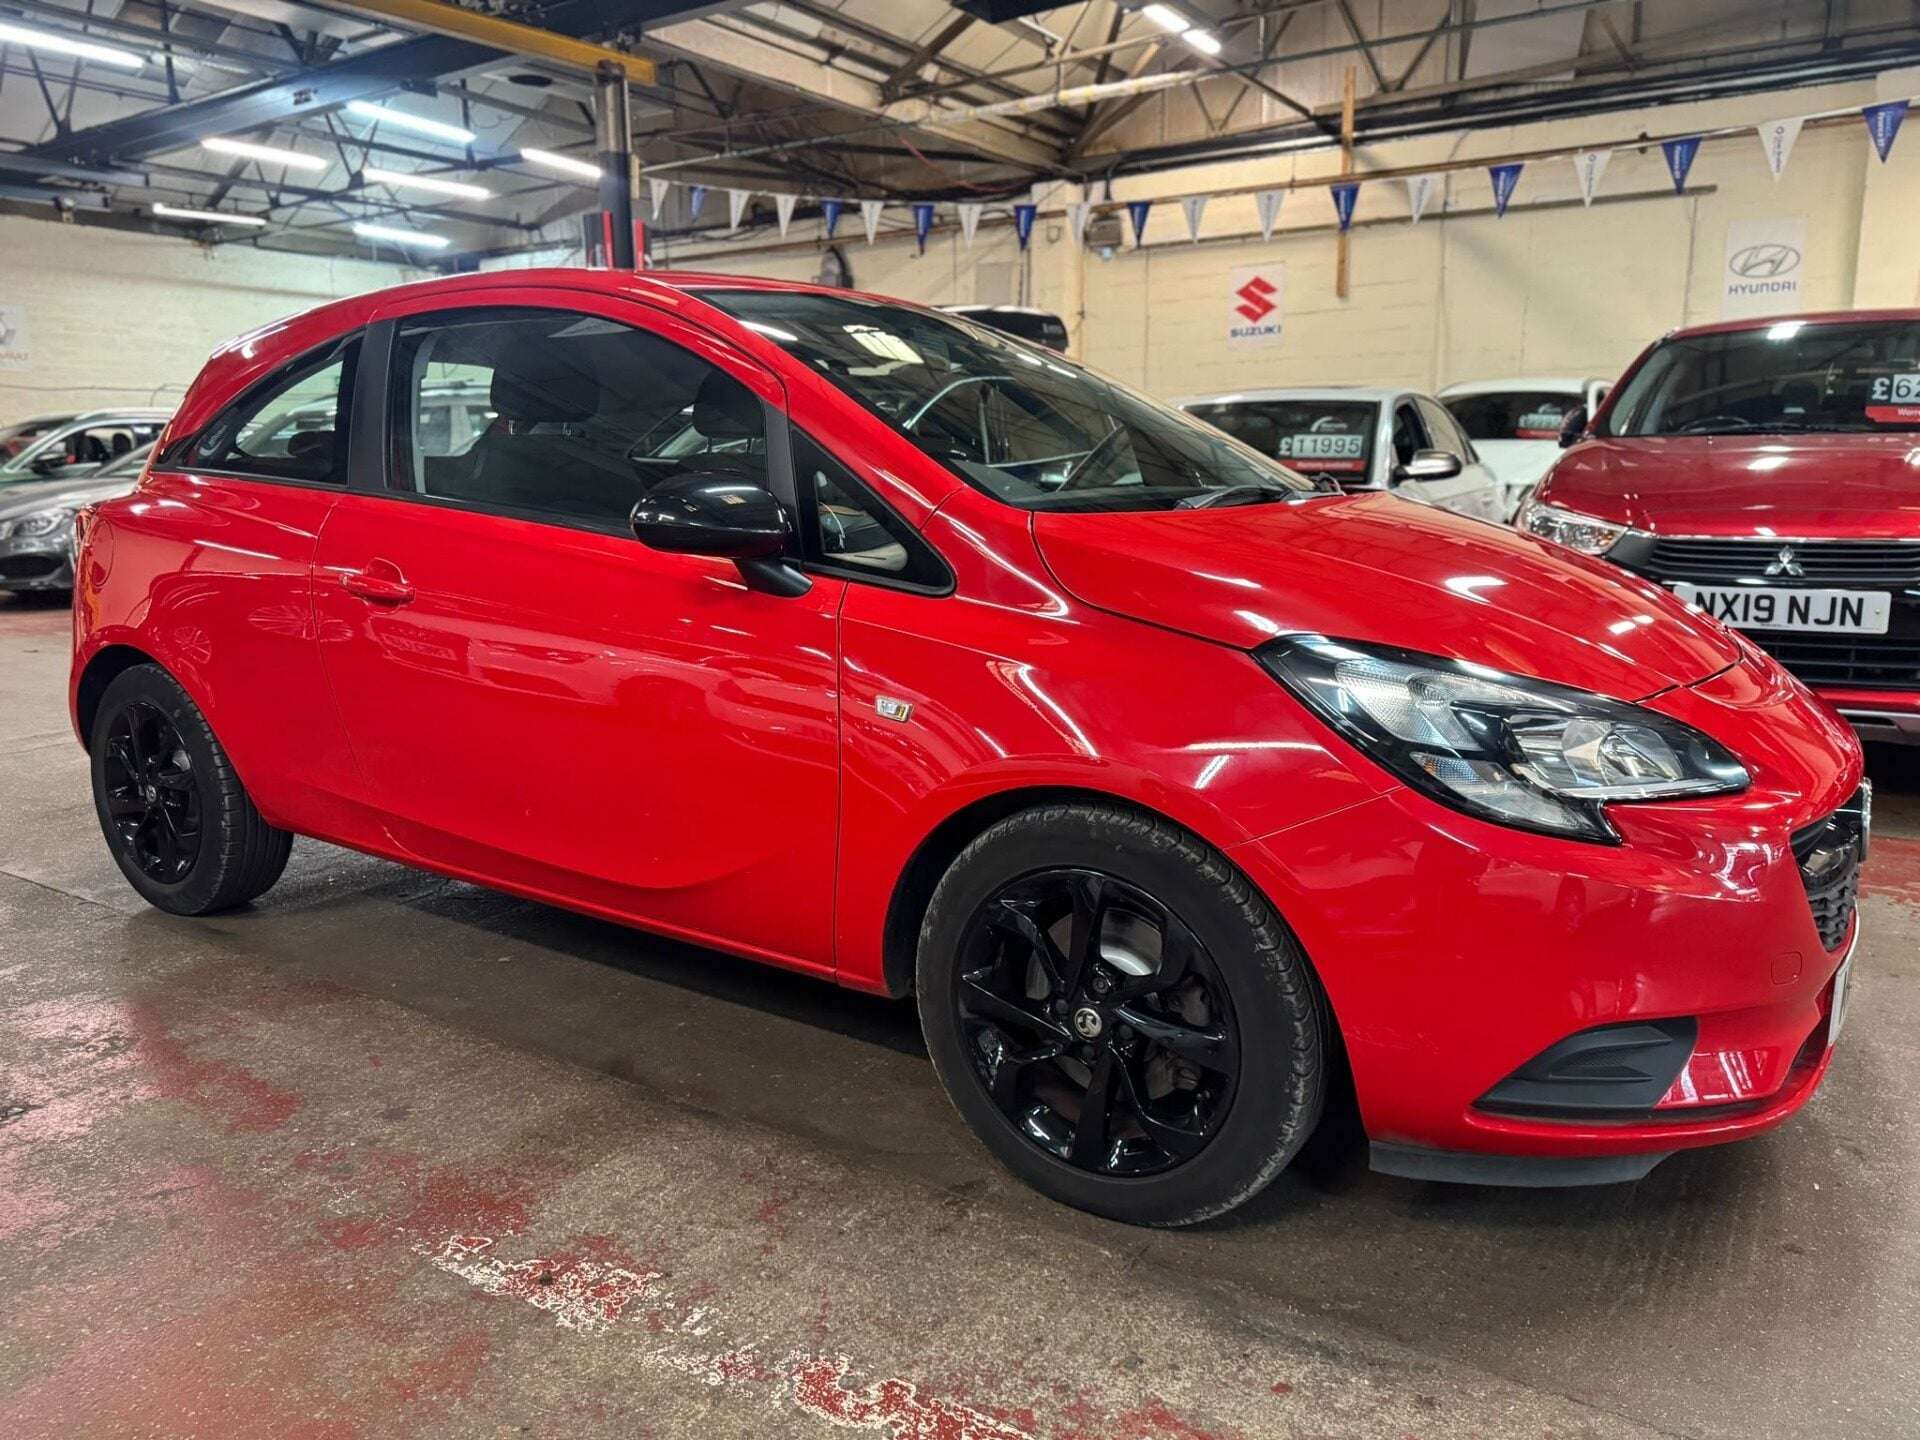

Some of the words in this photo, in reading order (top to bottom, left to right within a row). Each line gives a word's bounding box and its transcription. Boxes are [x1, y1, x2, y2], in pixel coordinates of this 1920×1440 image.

[1728, 281, 1797, 294] HYUNDAI
[1230, 324, 1281, 338] SUZUKI
[1695, 592, 1775, 622] NX19
[1787, 595, 1864, 626] NJN
